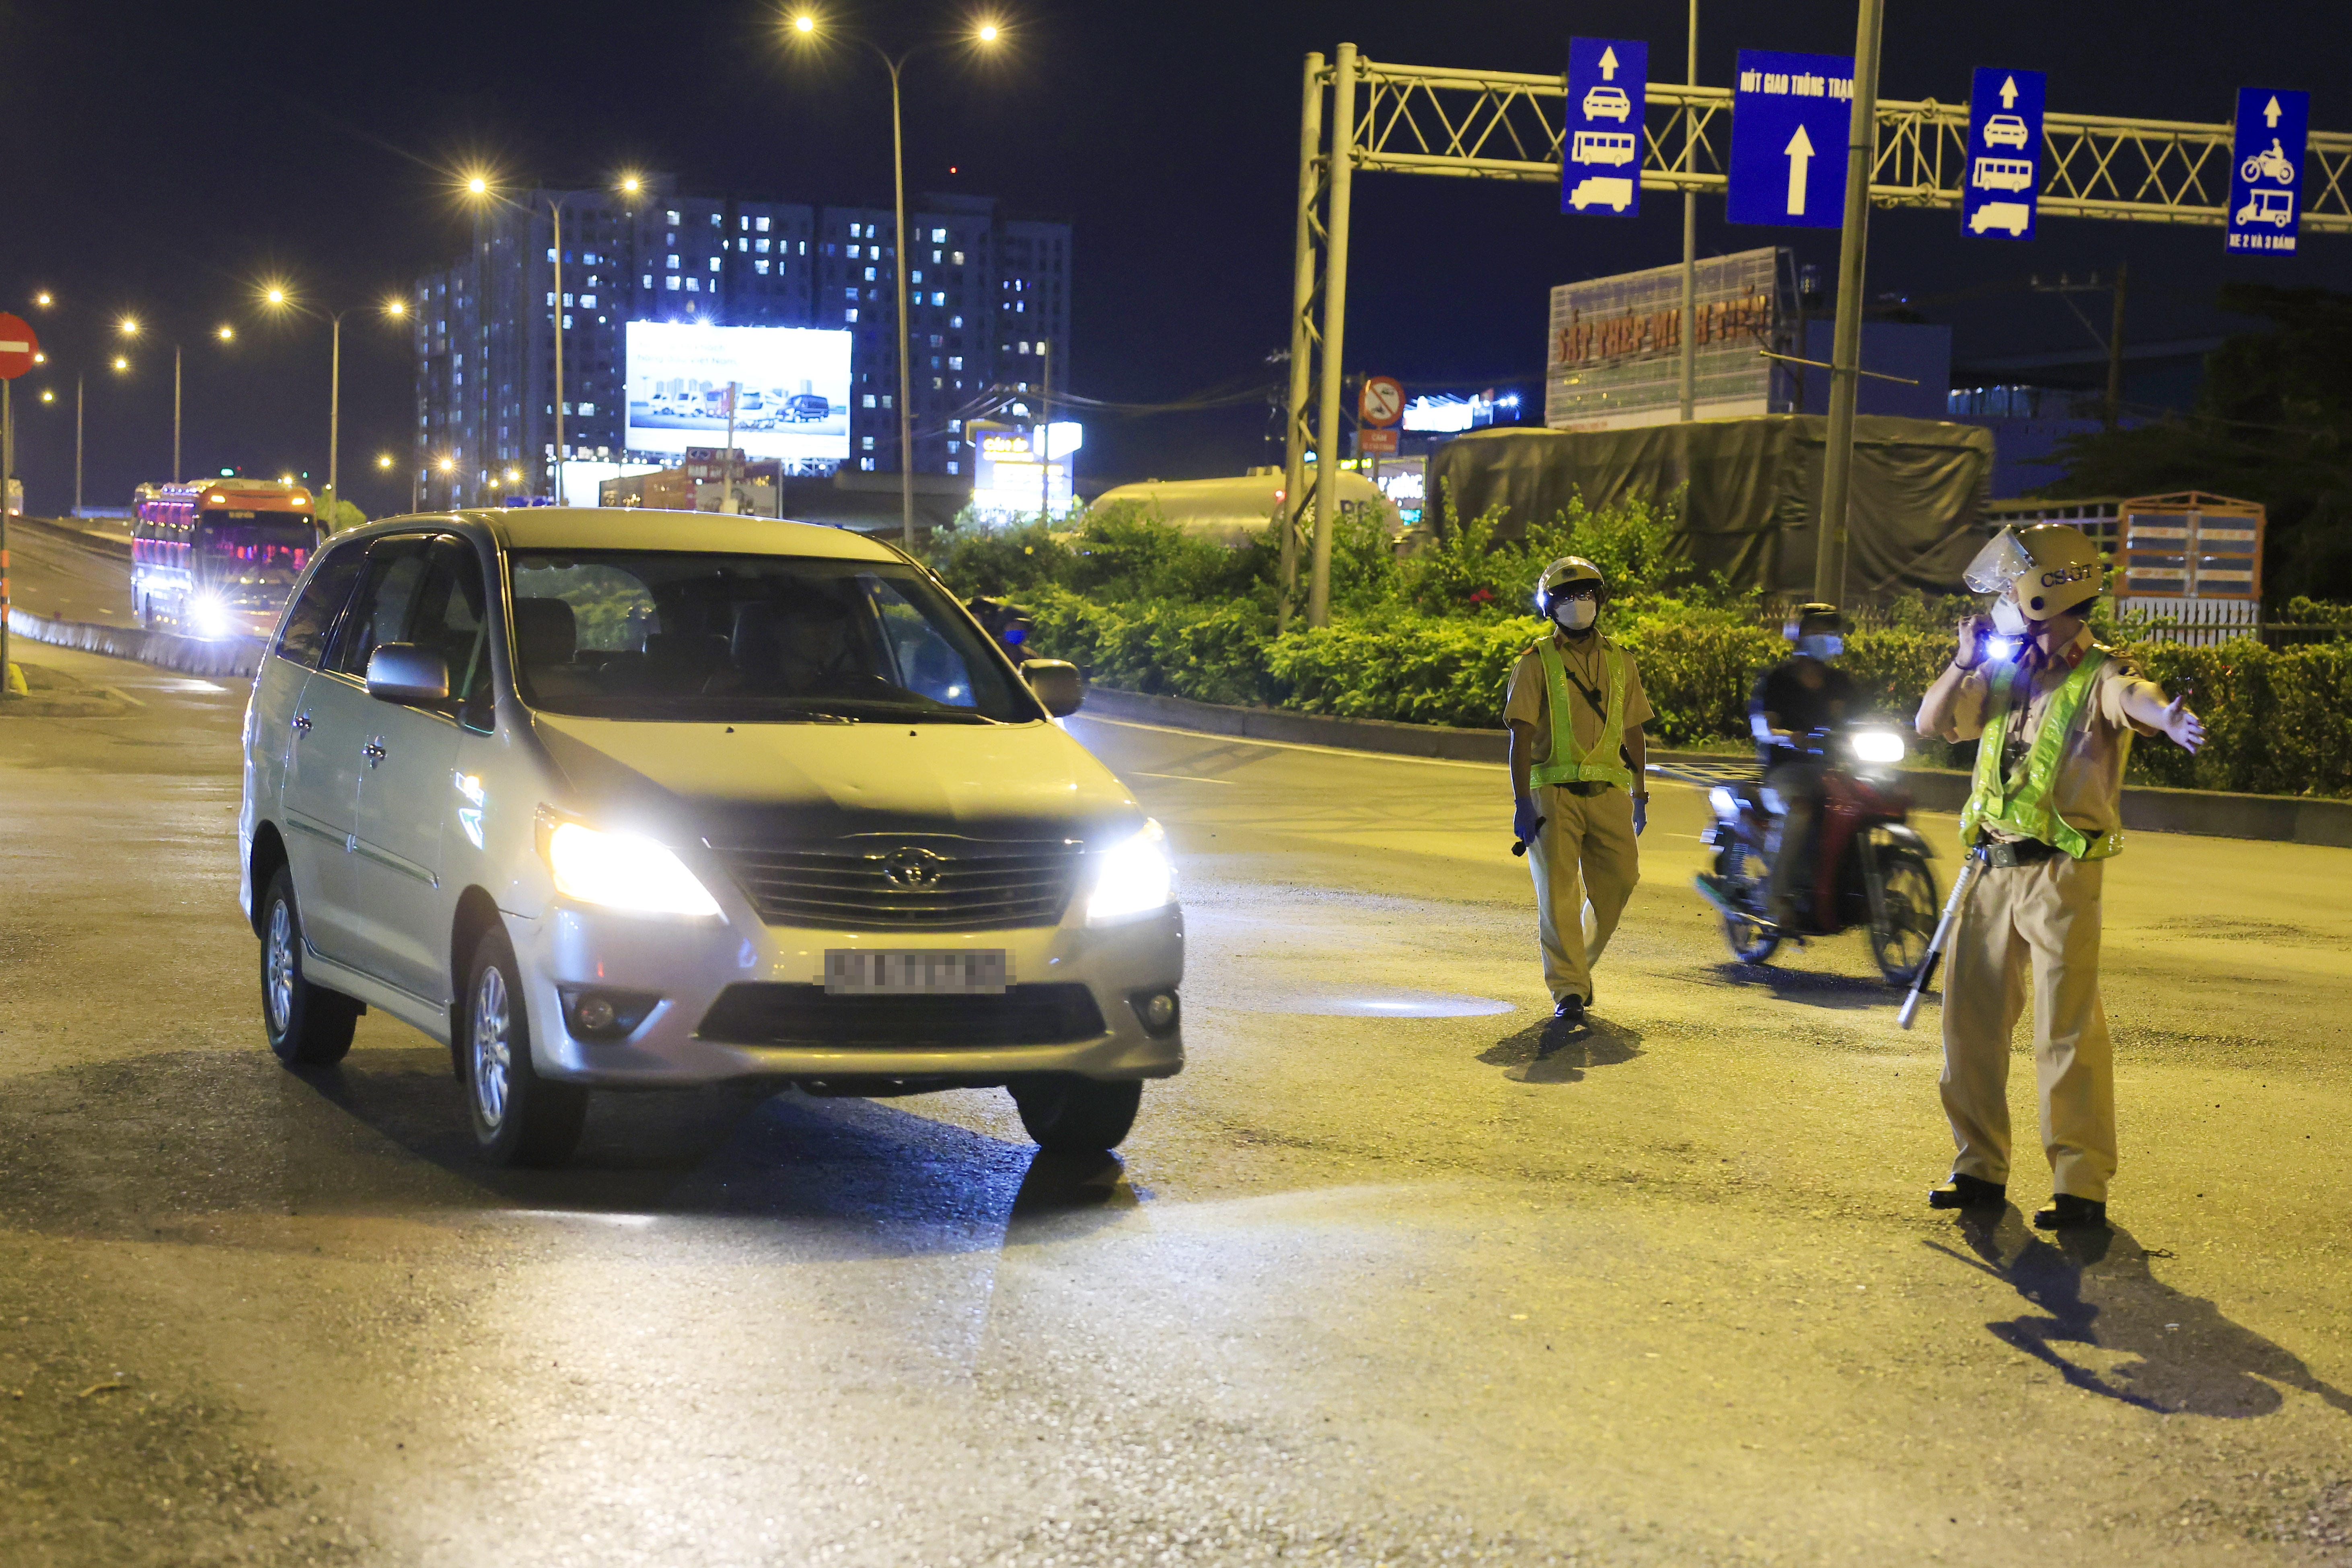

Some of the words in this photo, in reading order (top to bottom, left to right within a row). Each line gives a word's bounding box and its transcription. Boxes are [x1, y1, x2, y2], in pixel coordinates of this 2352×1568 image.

[1764, 73, 1789, 95] GIAO
[1791, 72, 1825, 97] THÔNG
[2229, 233, 2241, 247] XE
[2242, 234, 2249, 248] 2
[2251, 232, 2263, 249] VÀ
[2264, 235, 2272, 249] 3
[2041, 564, 2092, 588] CSGT
